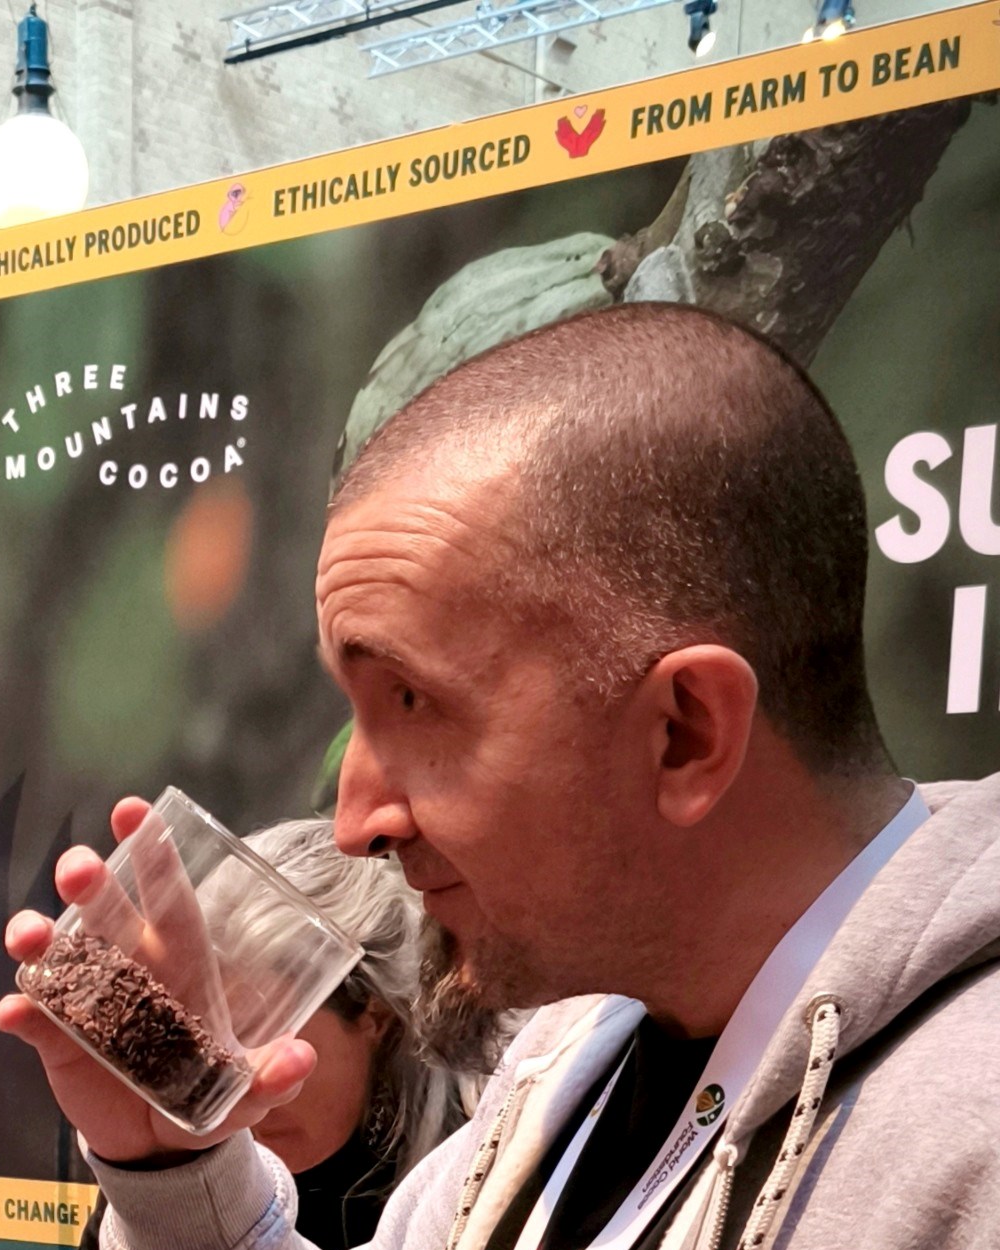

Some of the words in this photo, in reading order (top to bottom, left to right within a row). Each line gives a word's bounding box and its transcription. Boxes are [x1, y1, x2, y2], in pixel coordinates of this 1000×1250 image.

[630, 92, 713, 139] FROM
[723, 71, 807, 119] FARM
[818, 59, 859, 98] TO
[871, 35, 961, 86] BEAN
[273, 162, 401, 217] ETHICALLY
[408, 134, 531, 188] SOURCED
[84, 209, 201, 258] PRODUCED
[1, 364, 127, 433] THREE
[5, 392, 249, 480] MOUNTAINS
[641, 1120, 695, 1193] Foundation
[668, 1130, 699, 1172] World
[4, 1198, 80, 1226] CHANGE
